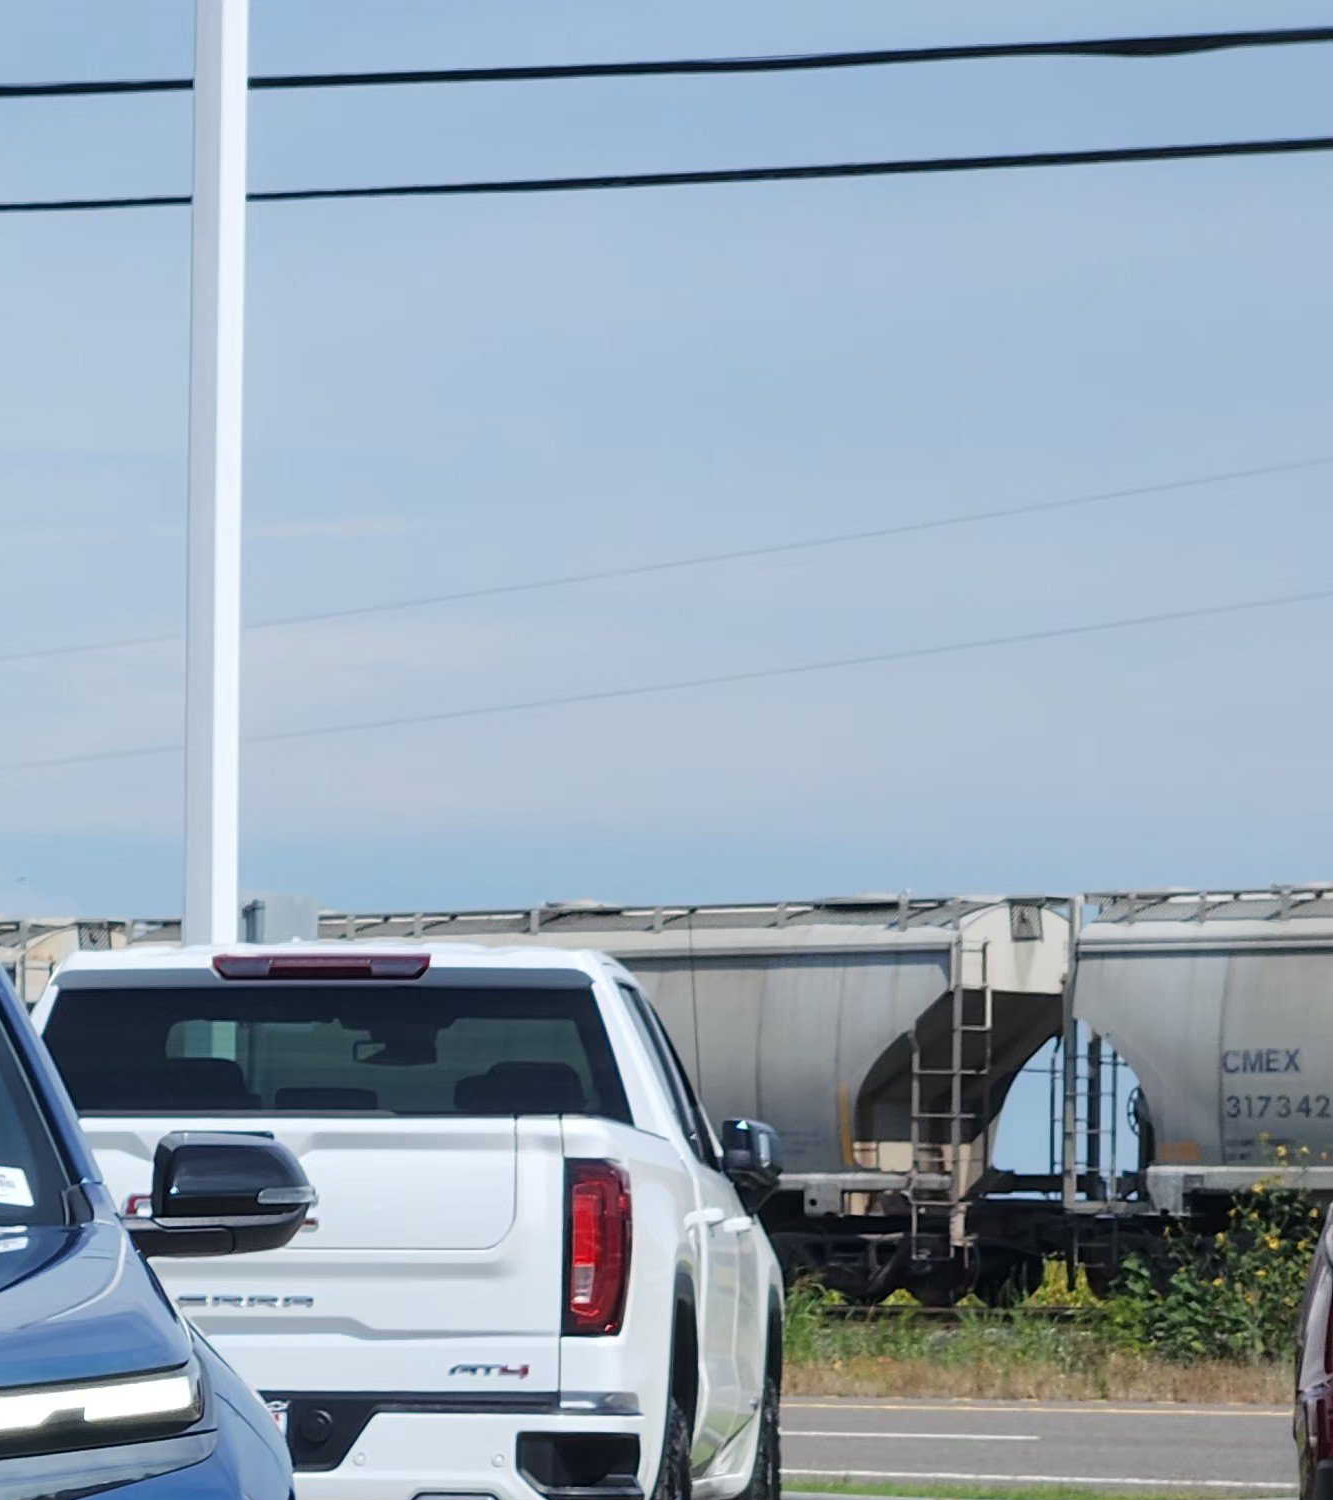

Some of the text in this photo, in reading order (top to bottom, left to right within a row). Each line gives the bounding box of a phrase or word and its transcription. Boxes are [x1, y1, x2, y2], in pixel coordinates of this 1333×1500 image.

[1221, 1048, 1301, 1073] CMEX
[1226, 1094, 1331, 1118] 317342
[175, 1293, 314, 1308] ERRA
[447, 1363, 530, 1380] AT4
